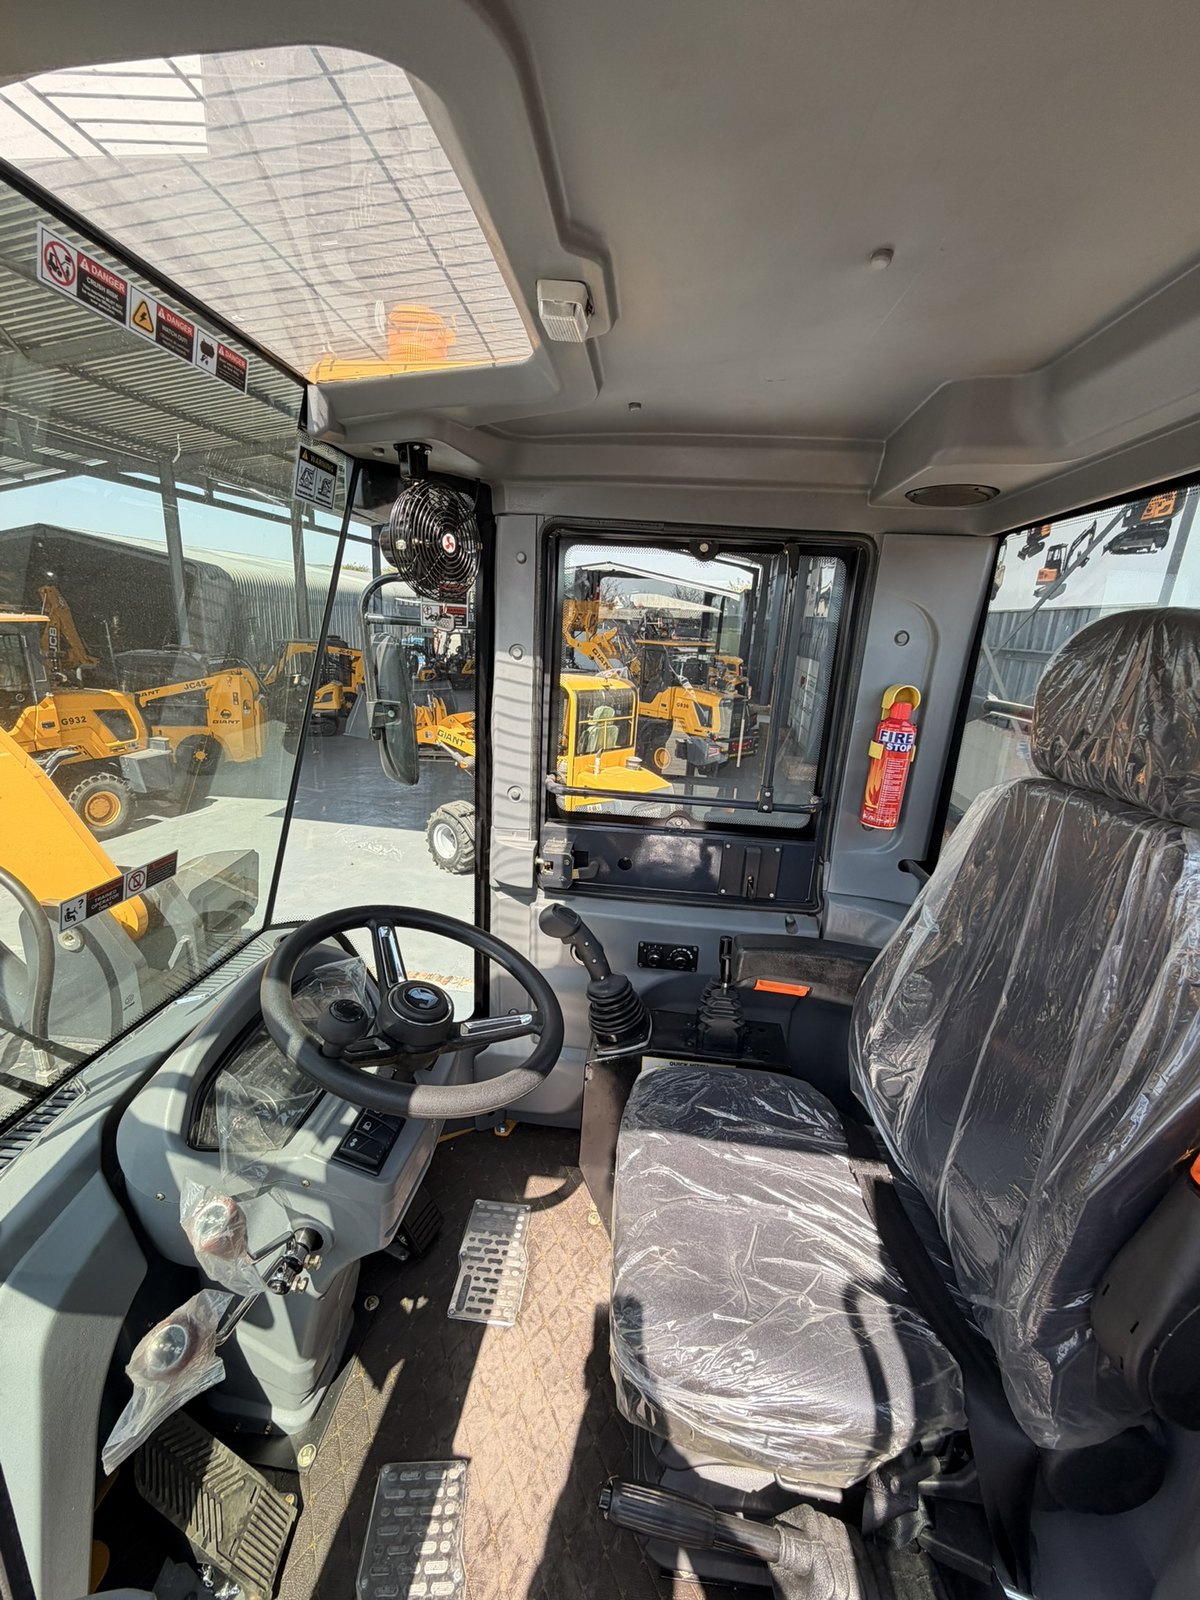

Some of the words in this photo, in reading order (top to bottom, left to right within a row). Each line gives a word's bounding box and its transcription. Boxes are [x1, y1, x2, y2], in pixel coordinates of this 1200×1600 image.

[91, 266, 125, 293] DANGER
[167, 314, 193, 337] DANGER
[184, 680, 207, 690] JC45
[60, 715, 87, 726] G932
[437, 729, 465, 747] GIANT
[880, 730, 914, 744] FIRE
[886, 743, 911, 752] STOP
[91, 893, 119, 910] OPERATOR
[95, 889, 117, 903] TRAINED
[98, 901, 112, 911] ONLY
